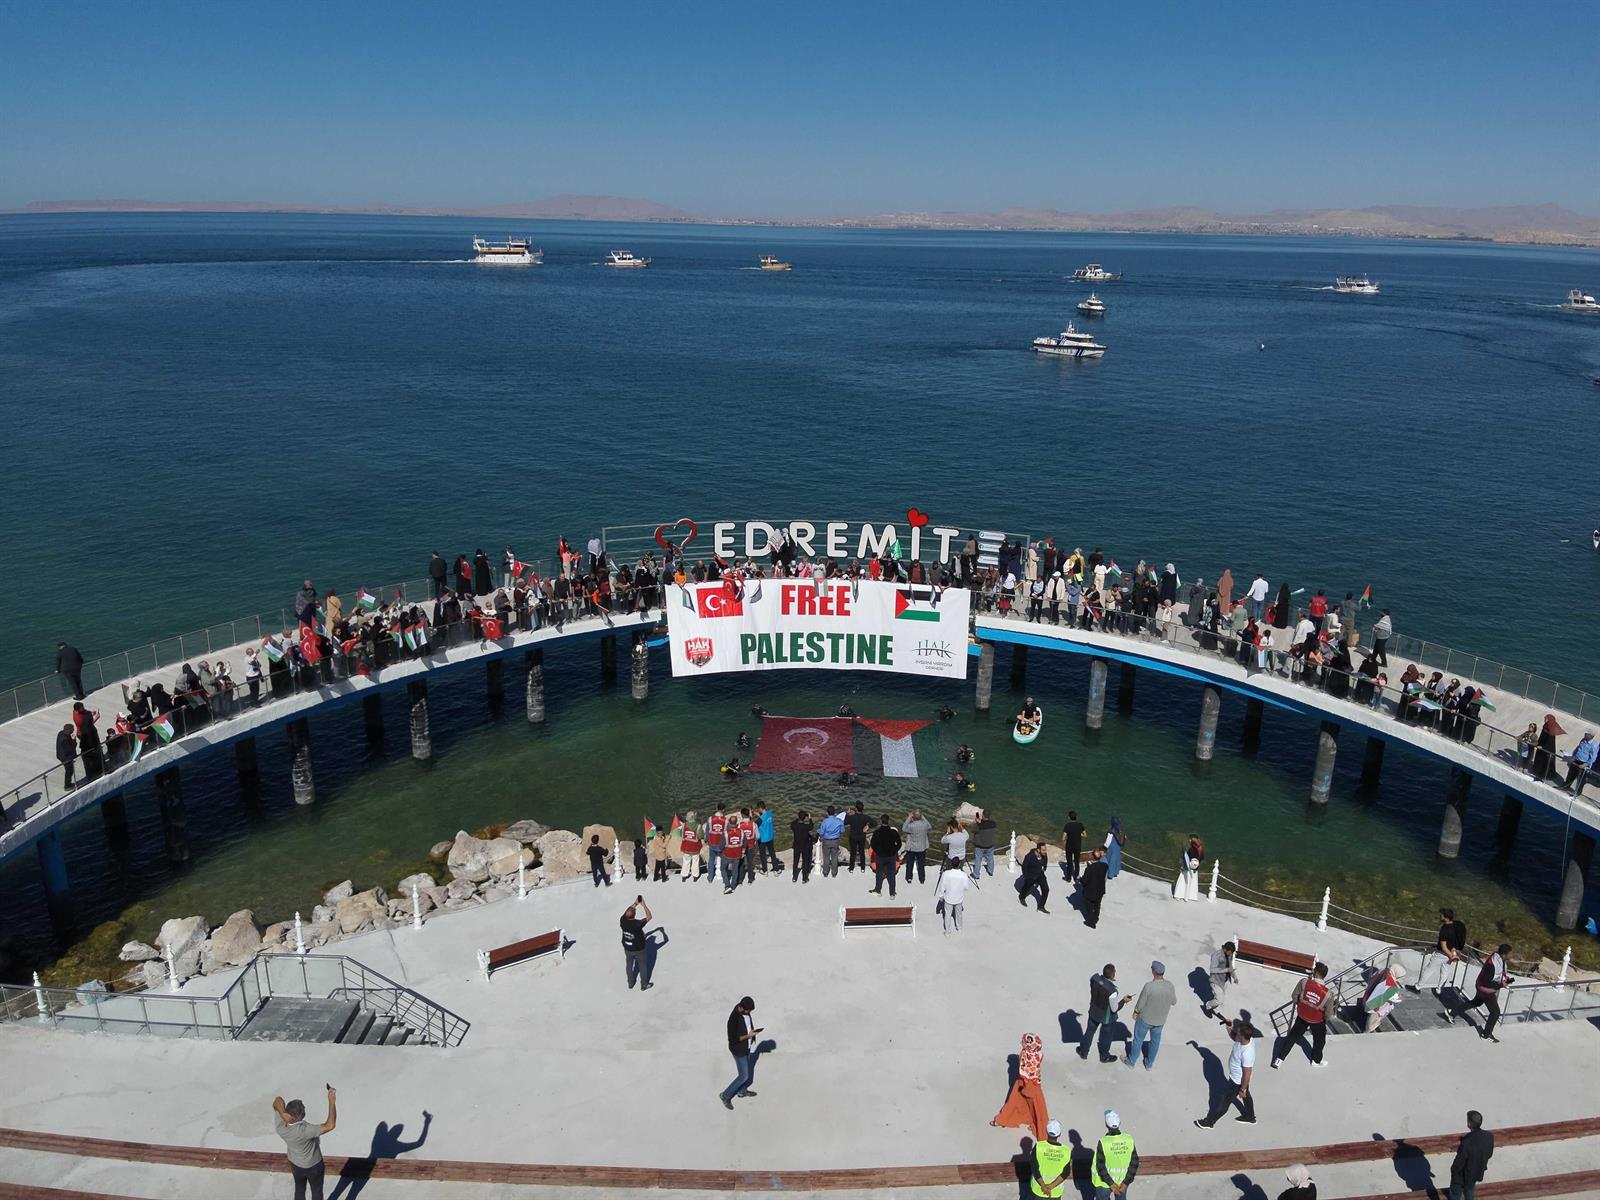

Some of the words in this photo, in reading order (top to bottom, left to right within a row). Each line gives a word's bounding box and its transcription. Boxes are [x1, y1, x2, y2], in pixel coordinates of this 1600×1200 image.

[781, 584, 851, 616] FREE
[687, 640, 710, 650] HAK
[740, 632, 894, 666] PALESTINE
[917, 640, 952, 658] HAK
